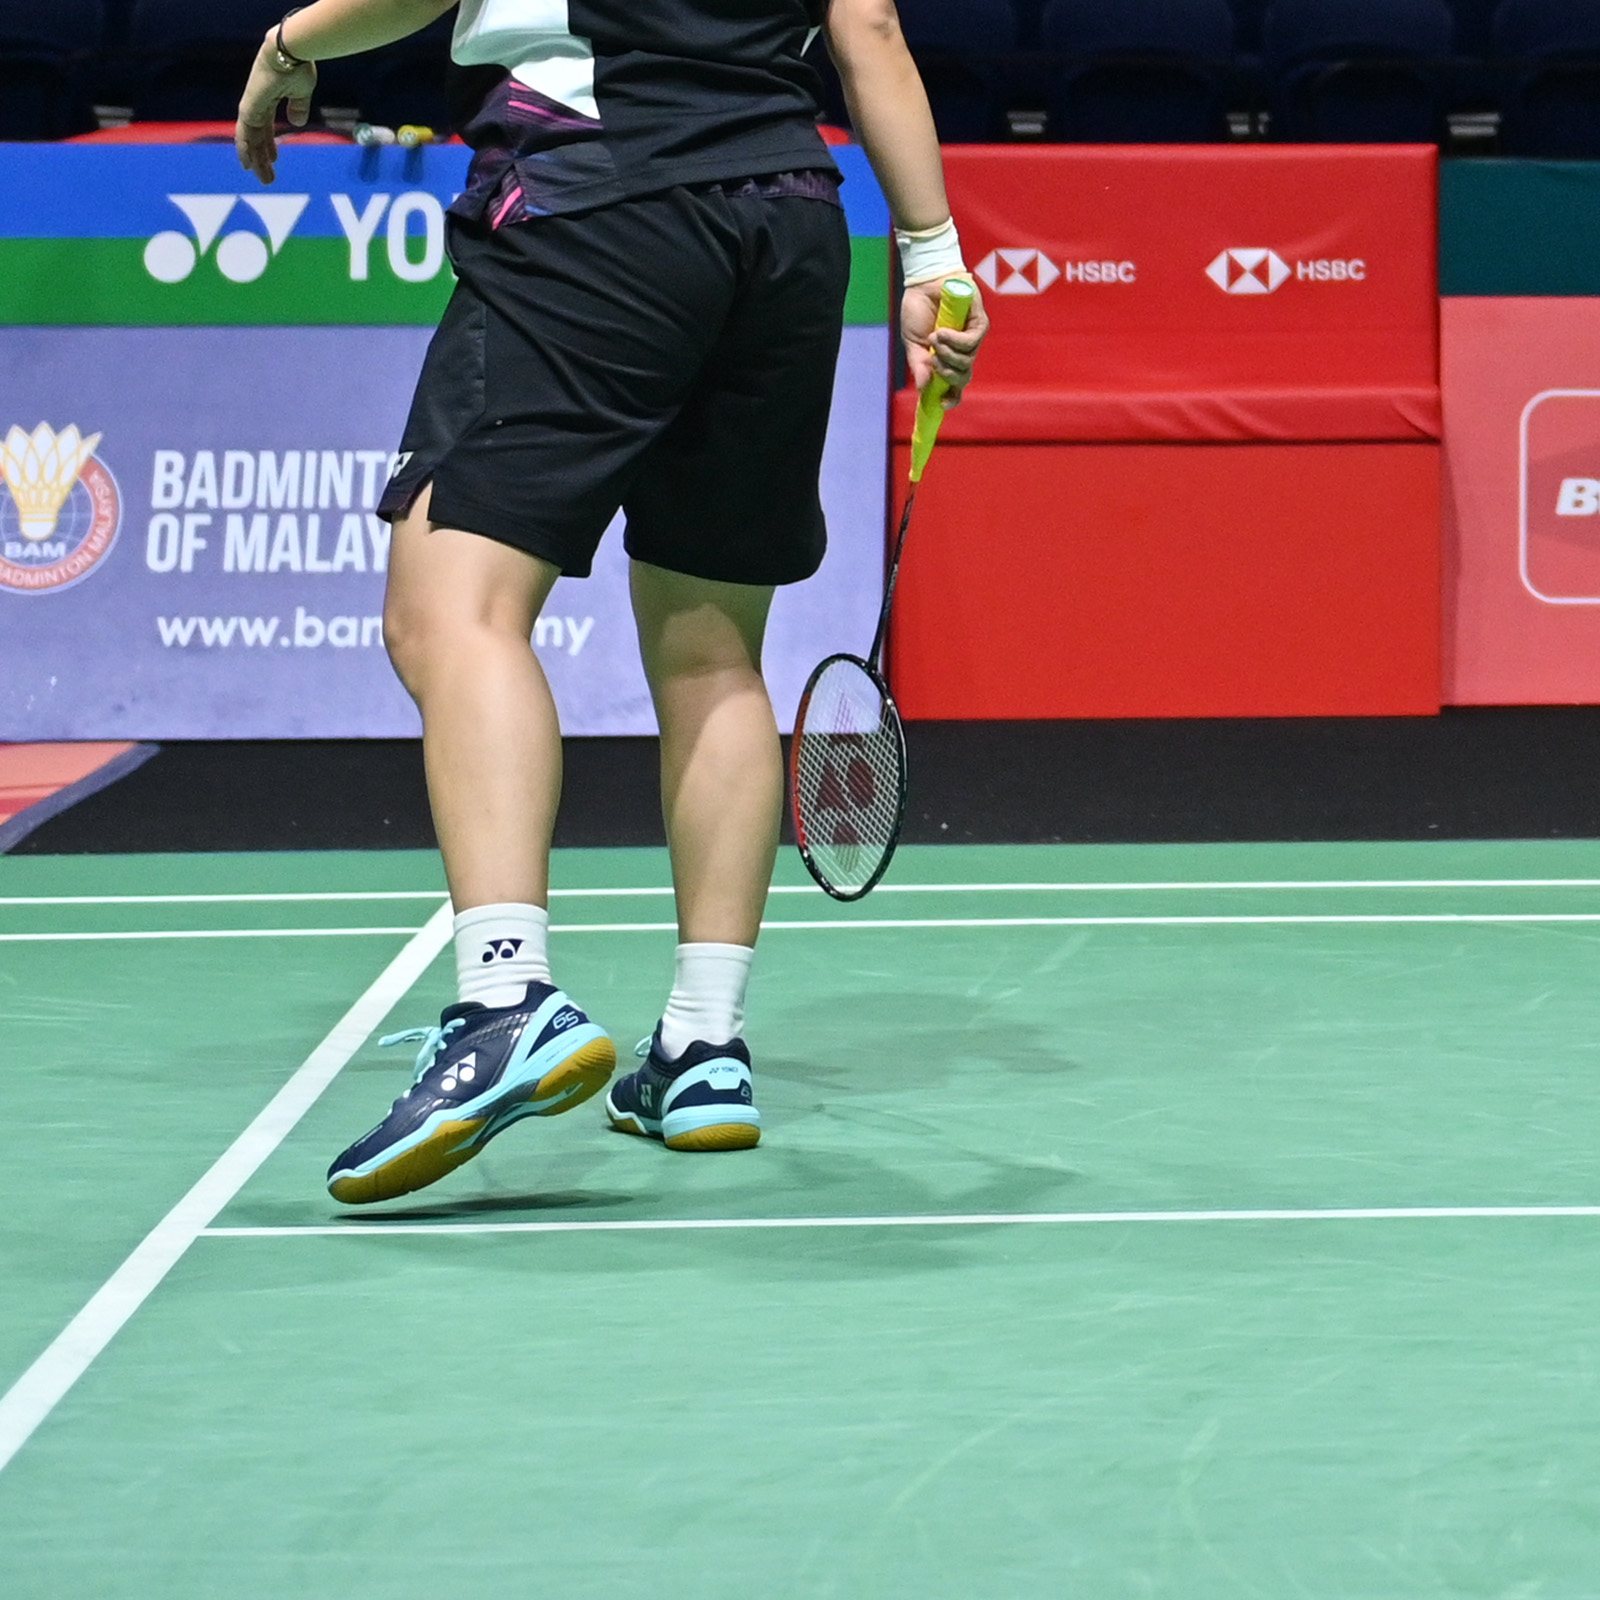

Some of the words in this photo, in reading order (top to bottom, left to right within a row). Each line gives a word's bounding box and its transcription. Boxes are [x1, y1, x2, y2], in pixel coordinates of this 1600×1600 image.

[1065, 260, 1137, 284] HSBC
[1296, 258, 1367, 282] HSBC
[151, 450, 400, 510] BADMINT
[4, 541, 66, 559] BAM
[146, 514, 211, 572] OF
[223, 514, 391, 572] MALAY
[0, 549, 93, 586] ADMINTON
[553, 1011, 579, 1029] 65
